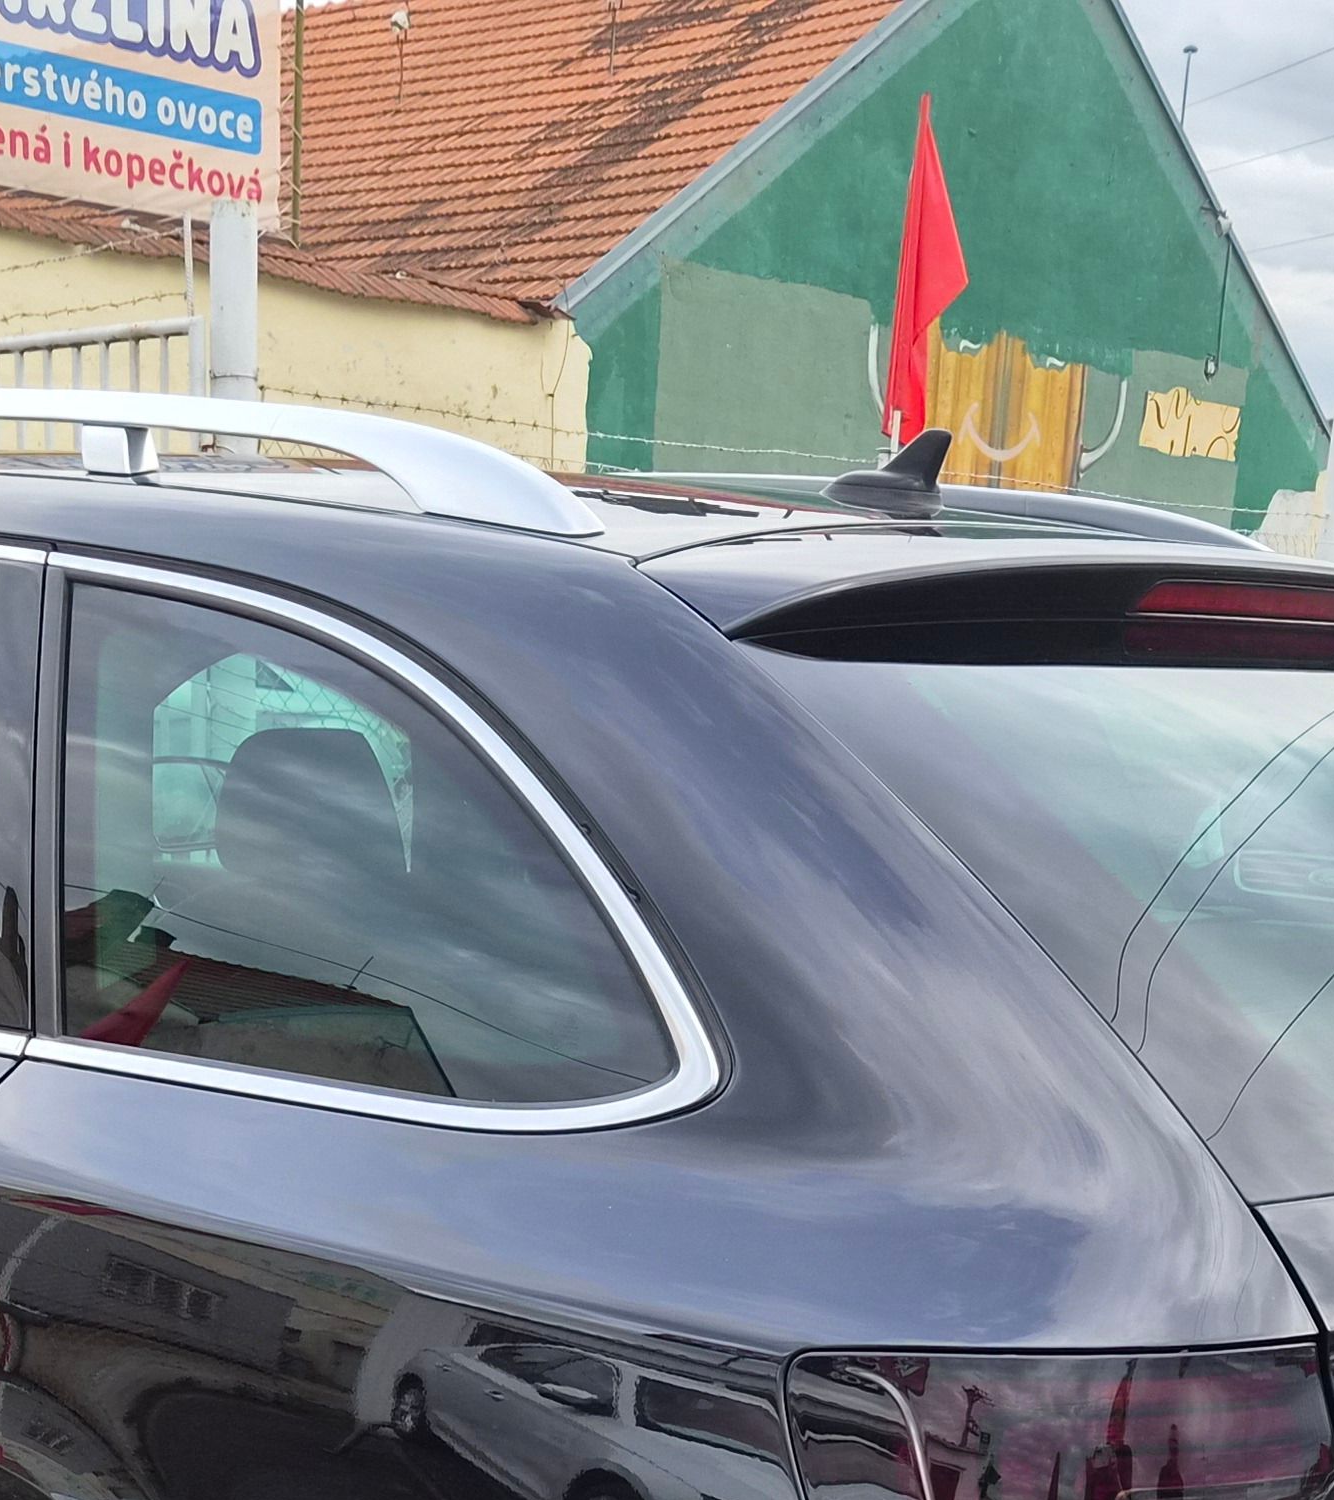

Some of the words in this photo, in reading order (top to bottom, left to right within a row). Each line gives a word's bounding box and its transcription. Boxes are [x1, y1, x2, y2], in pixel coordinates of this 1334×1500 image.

[156, 96, 254, 143] ovoce
[63, 131, 71, 169] i
[82, 136, 262, 205] kopečková
